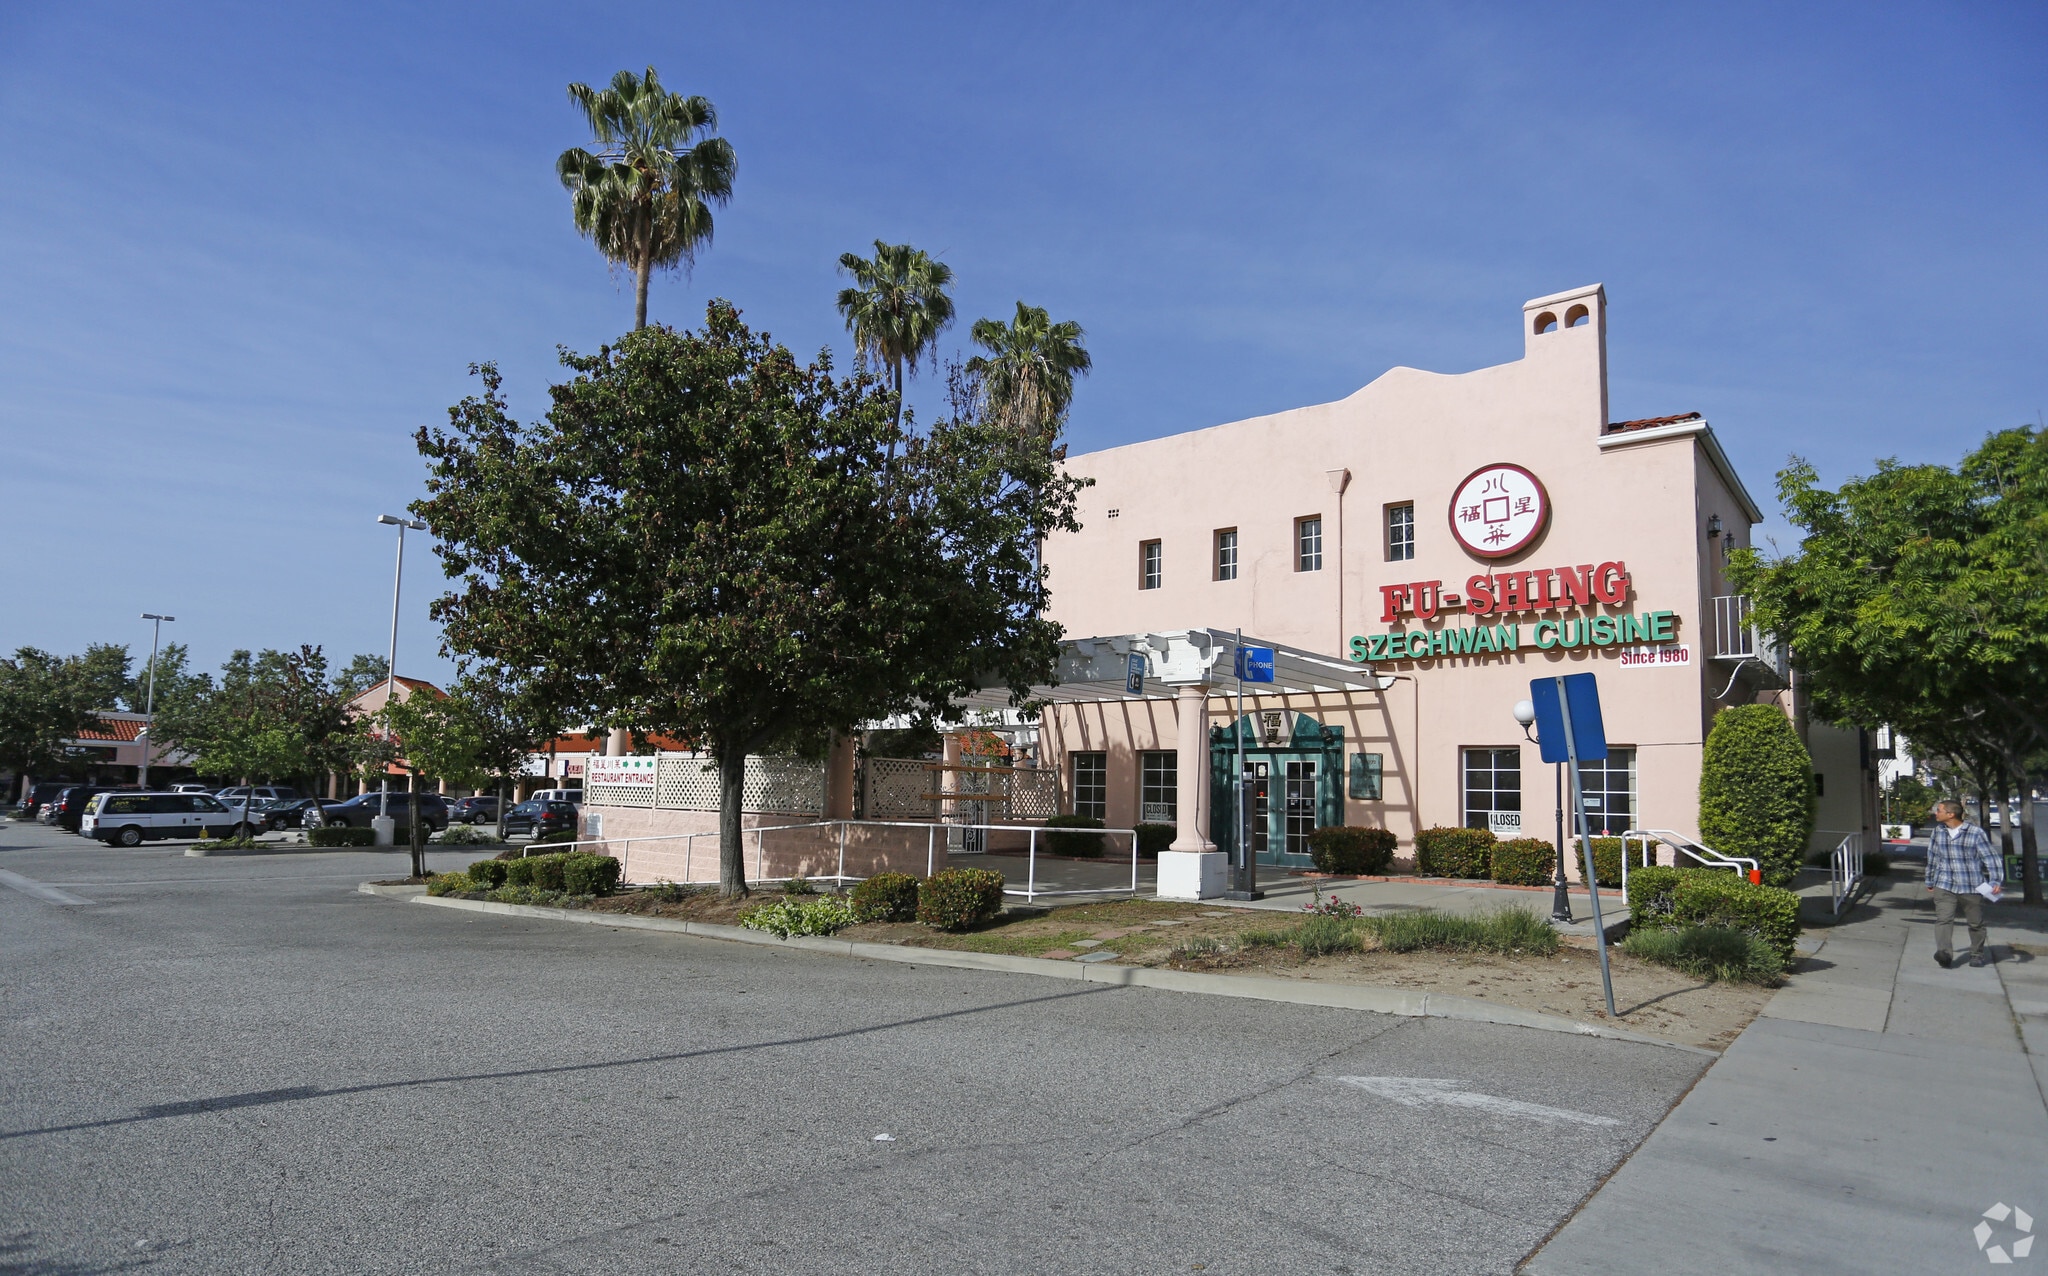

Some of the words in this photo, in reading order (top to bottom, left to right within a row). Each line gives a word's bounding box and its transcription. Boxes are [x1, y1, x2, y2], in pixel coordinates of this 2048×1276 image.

[1481, 473, 1510, 494] 川
[1458, 504, 1482, 523] 福
[1513, 496, 1536, 517] 星
[1379, 561, 1630, 623] FU-SHING
[1349, 623, 1518, 663] SZECHWAN
[1533, 610, 1675, 650] CUISINE
[1621, 651, 1655, 665] Since
[1658, 648, 1689, 663] 1980
[591, 772, 624, 783] RESTAURANT
[625, 773, 653, 784] ENTRANCE
